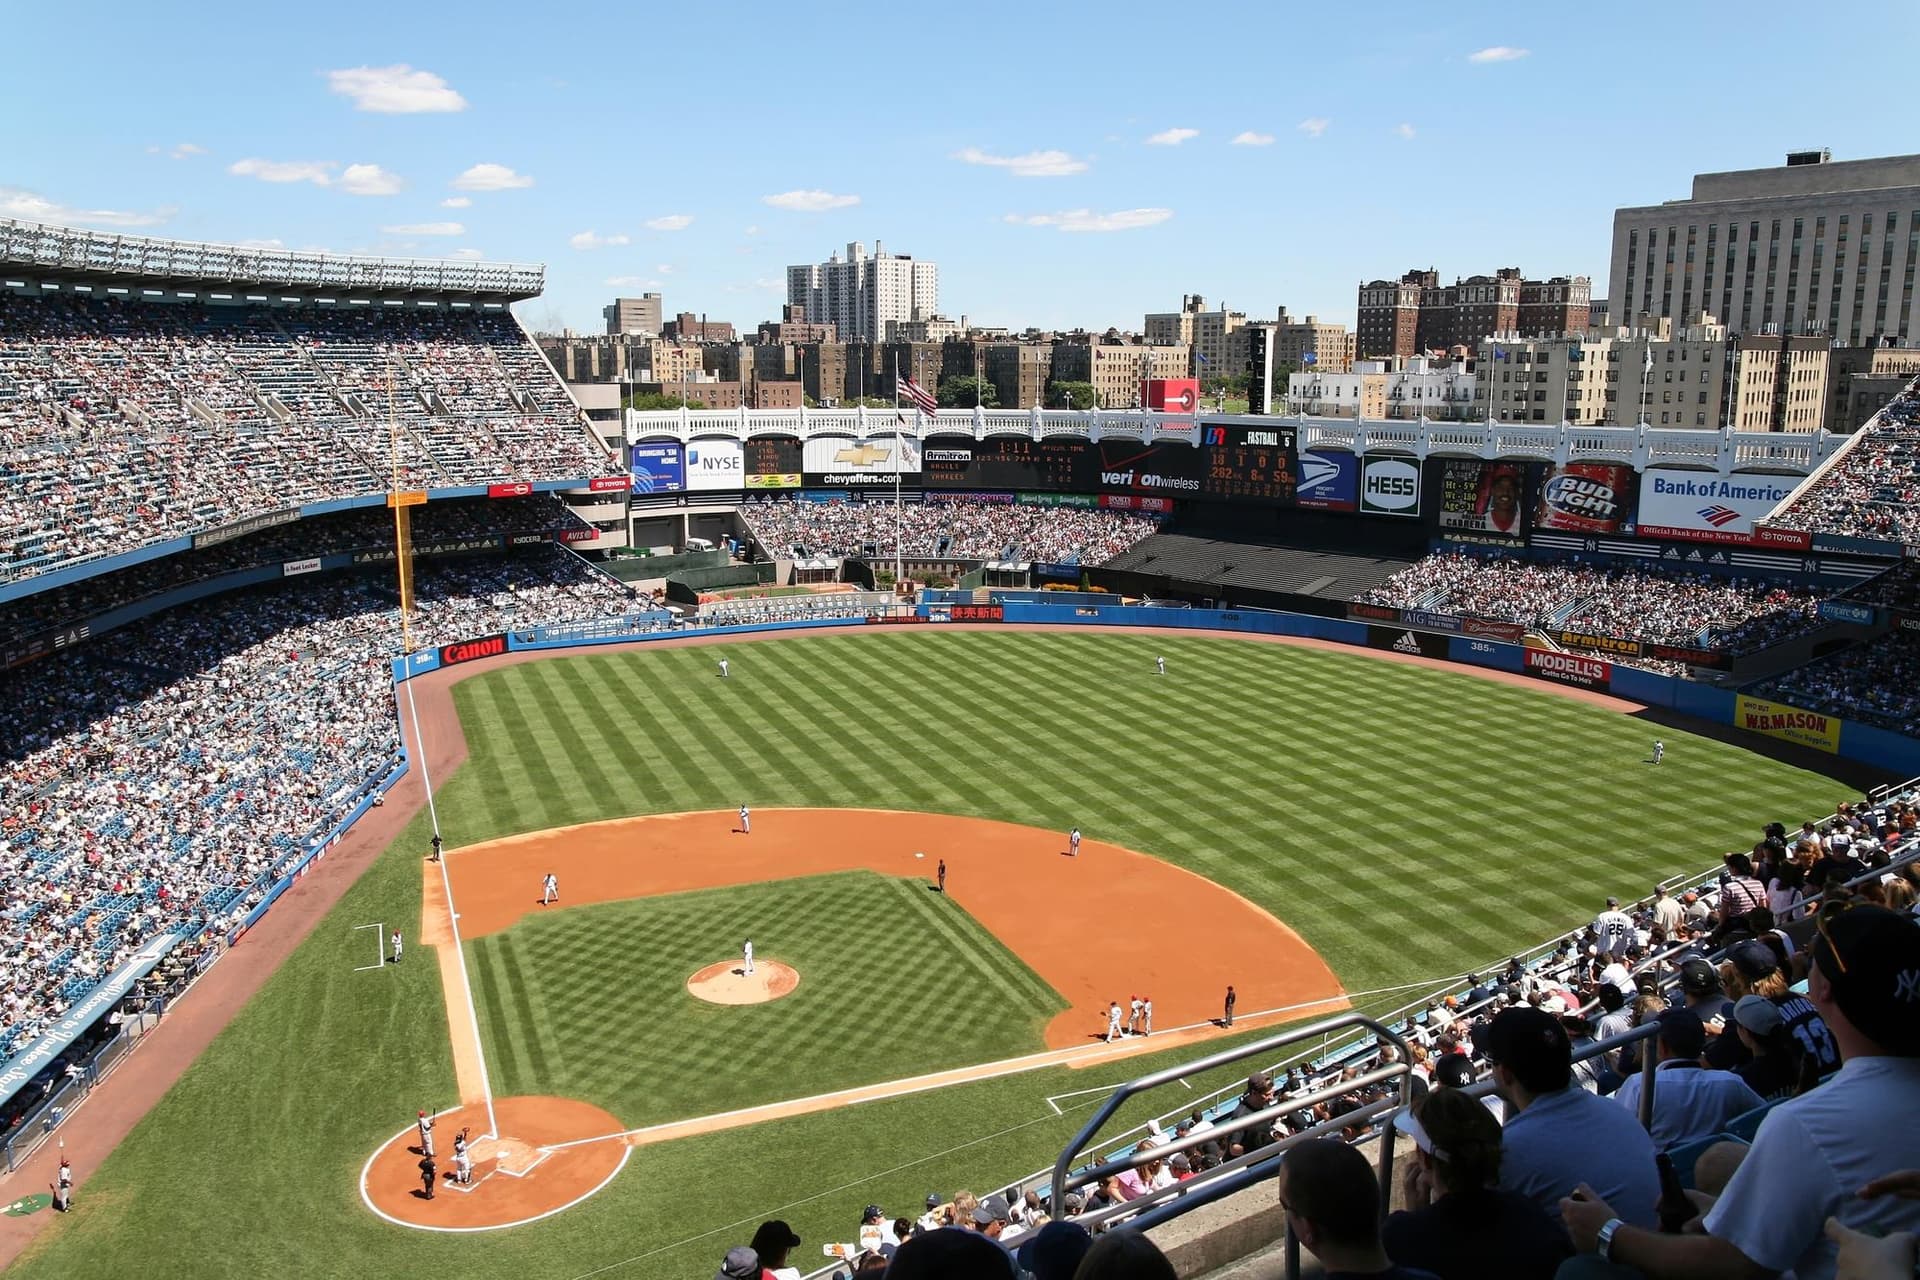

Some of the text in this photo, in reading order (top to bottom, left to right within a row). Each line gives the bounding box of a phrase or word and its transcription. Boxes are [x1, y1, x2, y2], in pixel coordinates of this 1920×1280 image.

[1247, 431, 1278, 446] FASTBALL
[1284, 437, 1290, 447] 5
[926, 451, 970, 460] Armitron
[703, 457, 740, 470] NYSE
[823, 474, 902, 485] chevyoffers.com
[1367, 476, 1414, 496] HESS
[1446, 481, 1456, 489] Ht
[1559, 477, 1615, 501] BUD
[1654, 478, 1696, 496] Bank
[1699, 480, 1719, 497] of
[1547, 487, 1618, 515] LIGHT
[1447, 519, 1487, 530] CABRERA
[567, 532, 584, 540] AVIS
[1643, 526, 1750, 543] Official Bank of the New York
[1772, 533, 1803, 545] TOYOTA
[1822, 602, 1852, 617] Empire
[1405, 612, 1425, 625] AIG
[1468, 623, 1516, 633] Budweiser
[1393, 643, 1421, 653] adidas
[1561, 632, 1638, 652] Armitron
[443, 637, 504, 664] Canon
[1531, 652, 1603, 679] MODELL'S
[1560, 672, 1570, 680] Go
[1570, 674, 1578, 682] To
[1758, 704, 1769, 712] BUT
[1609, 923, 1623, 935] 25
[73, 982, 124, 1020] Welcome
[61, 1019, 79, 1030] to
[20, 1028, 74, 1066] Yankee
[1792, 1017, 1836, 1064] 13
